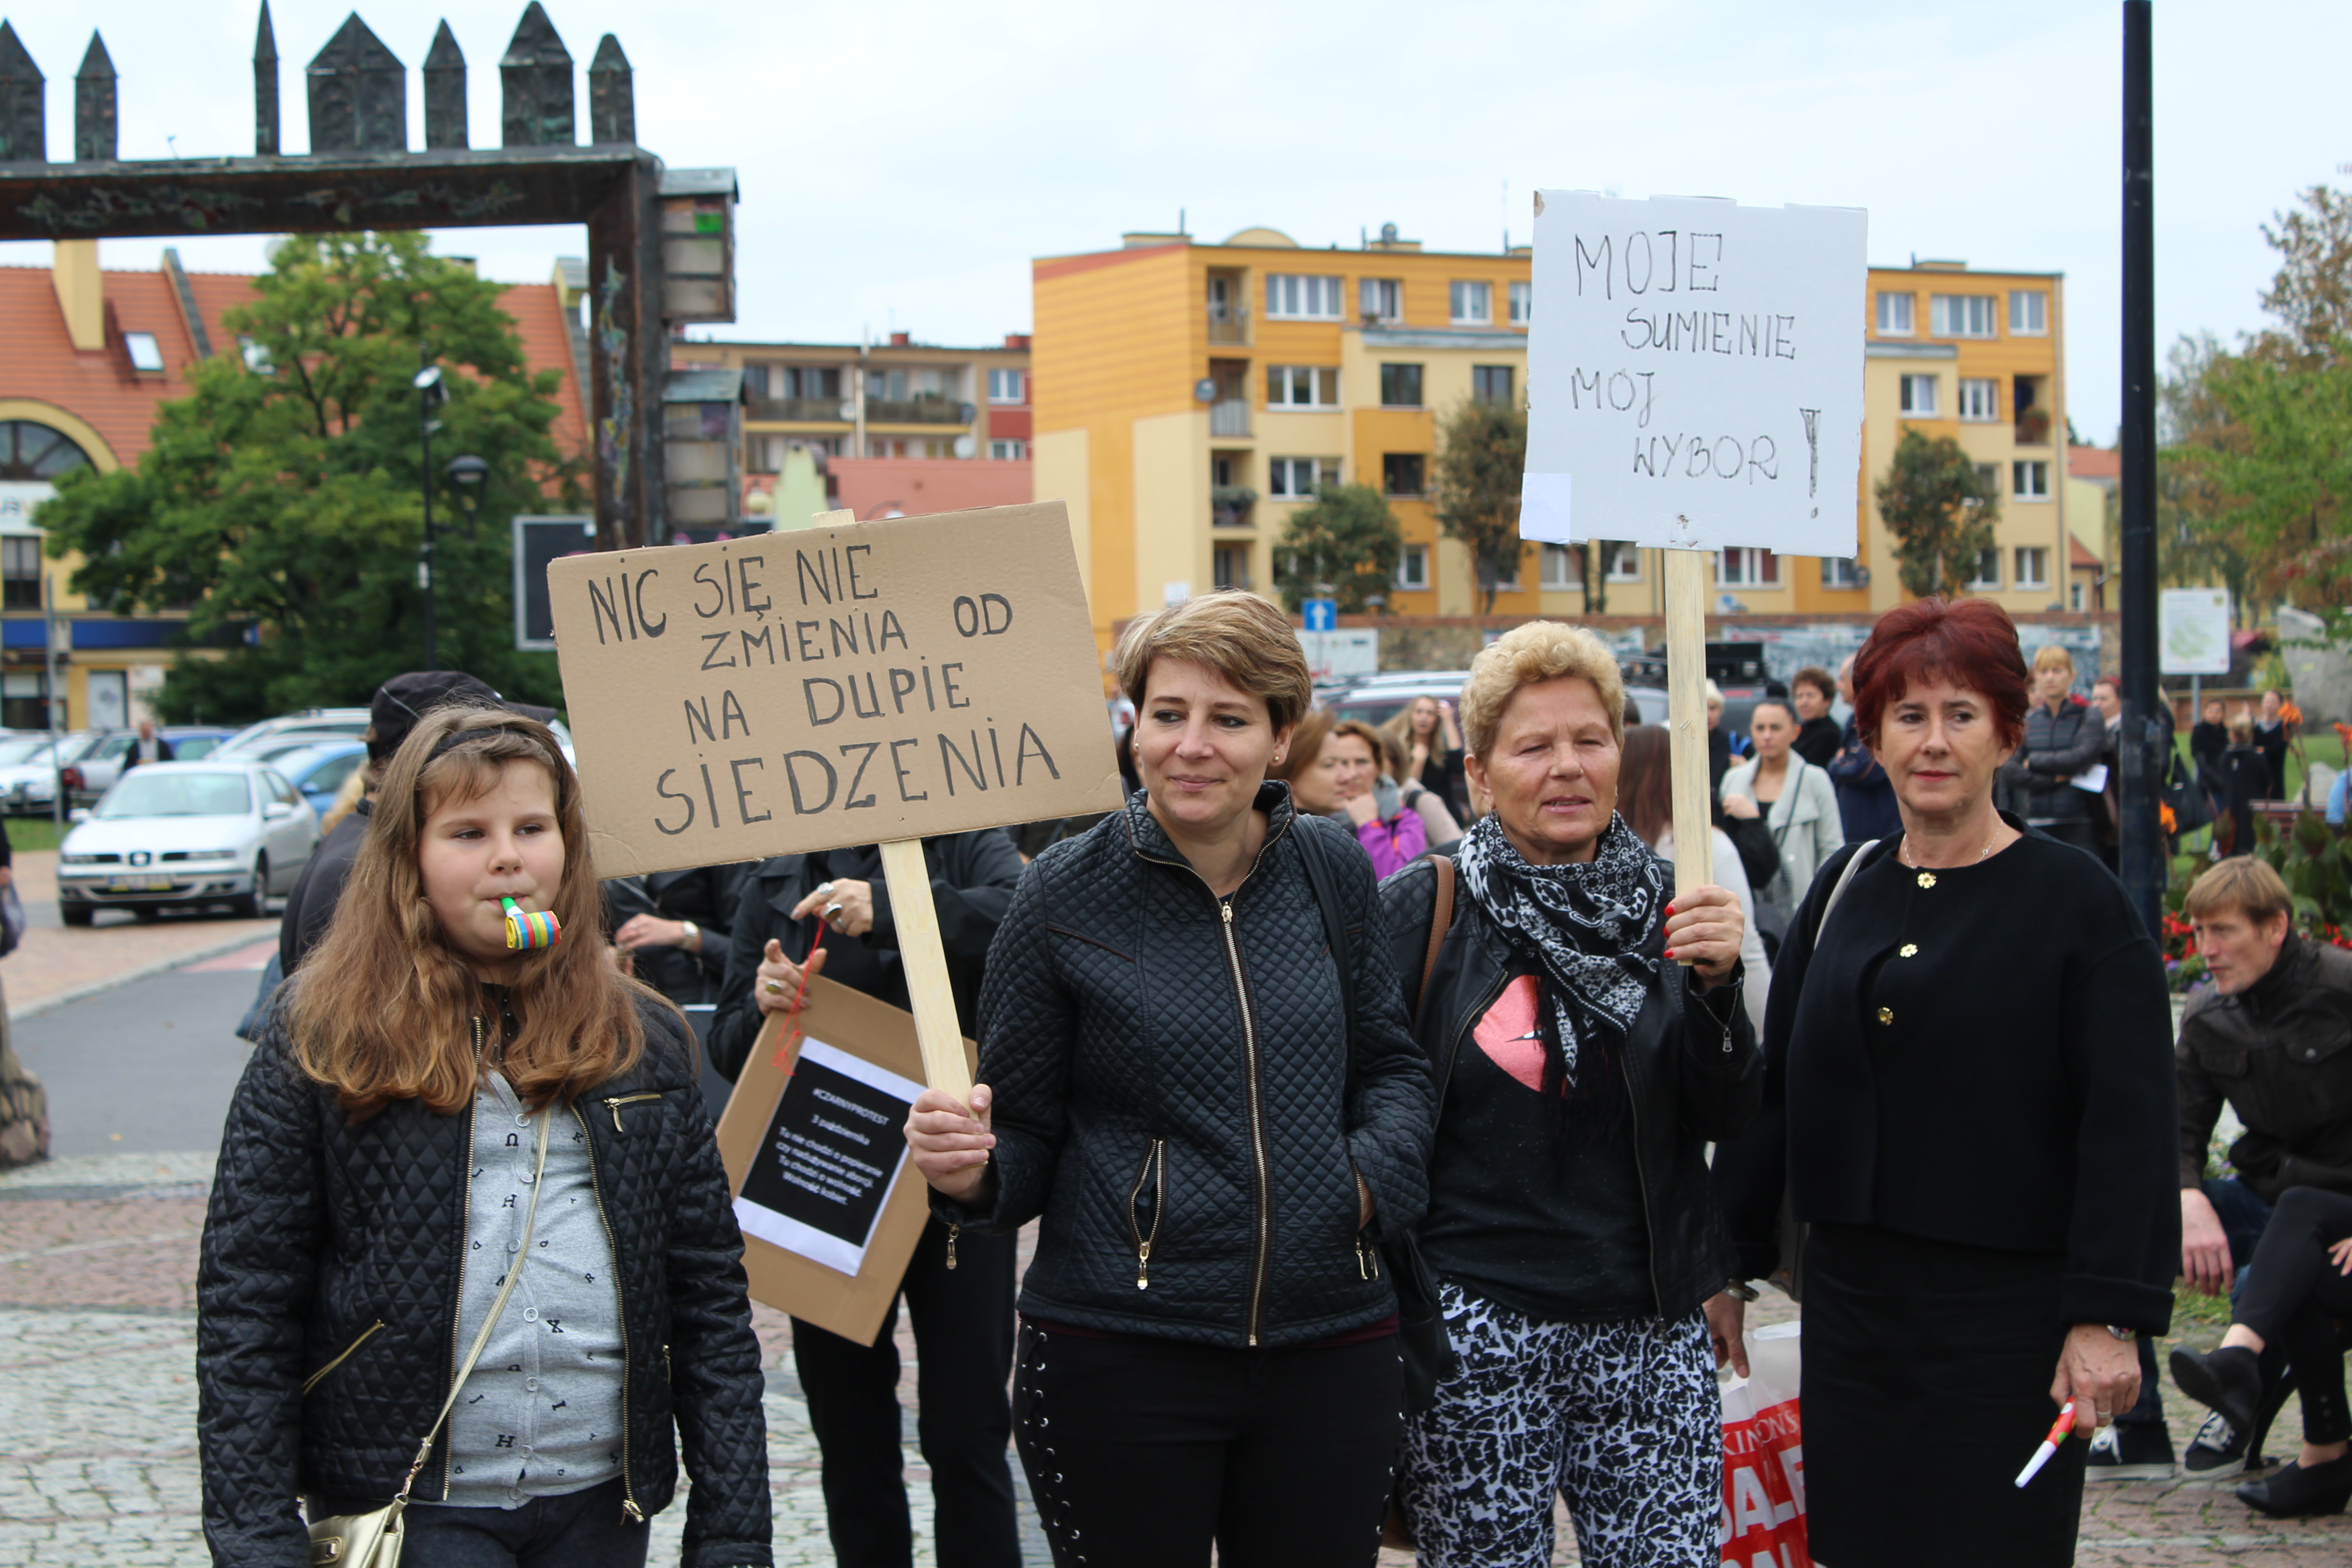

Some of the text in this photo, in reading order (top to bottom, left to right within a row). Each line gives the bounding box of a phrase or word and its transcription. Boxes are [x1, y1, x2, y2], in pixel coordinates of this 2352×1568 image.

[1575, 230, 1722, 300] MOJE
[1621, 308, 1796, 359] SUMIENIE
[589, 534, 877, 645] NIC SIĘ NIE
[701, 593, 1013, 671] ZMIENIA OD
[684, 656, 970, 745] NA DUPIE
[655, 717, 1061, 835] SIEDZENIA
[811, 1114, 820, 1124] 3
